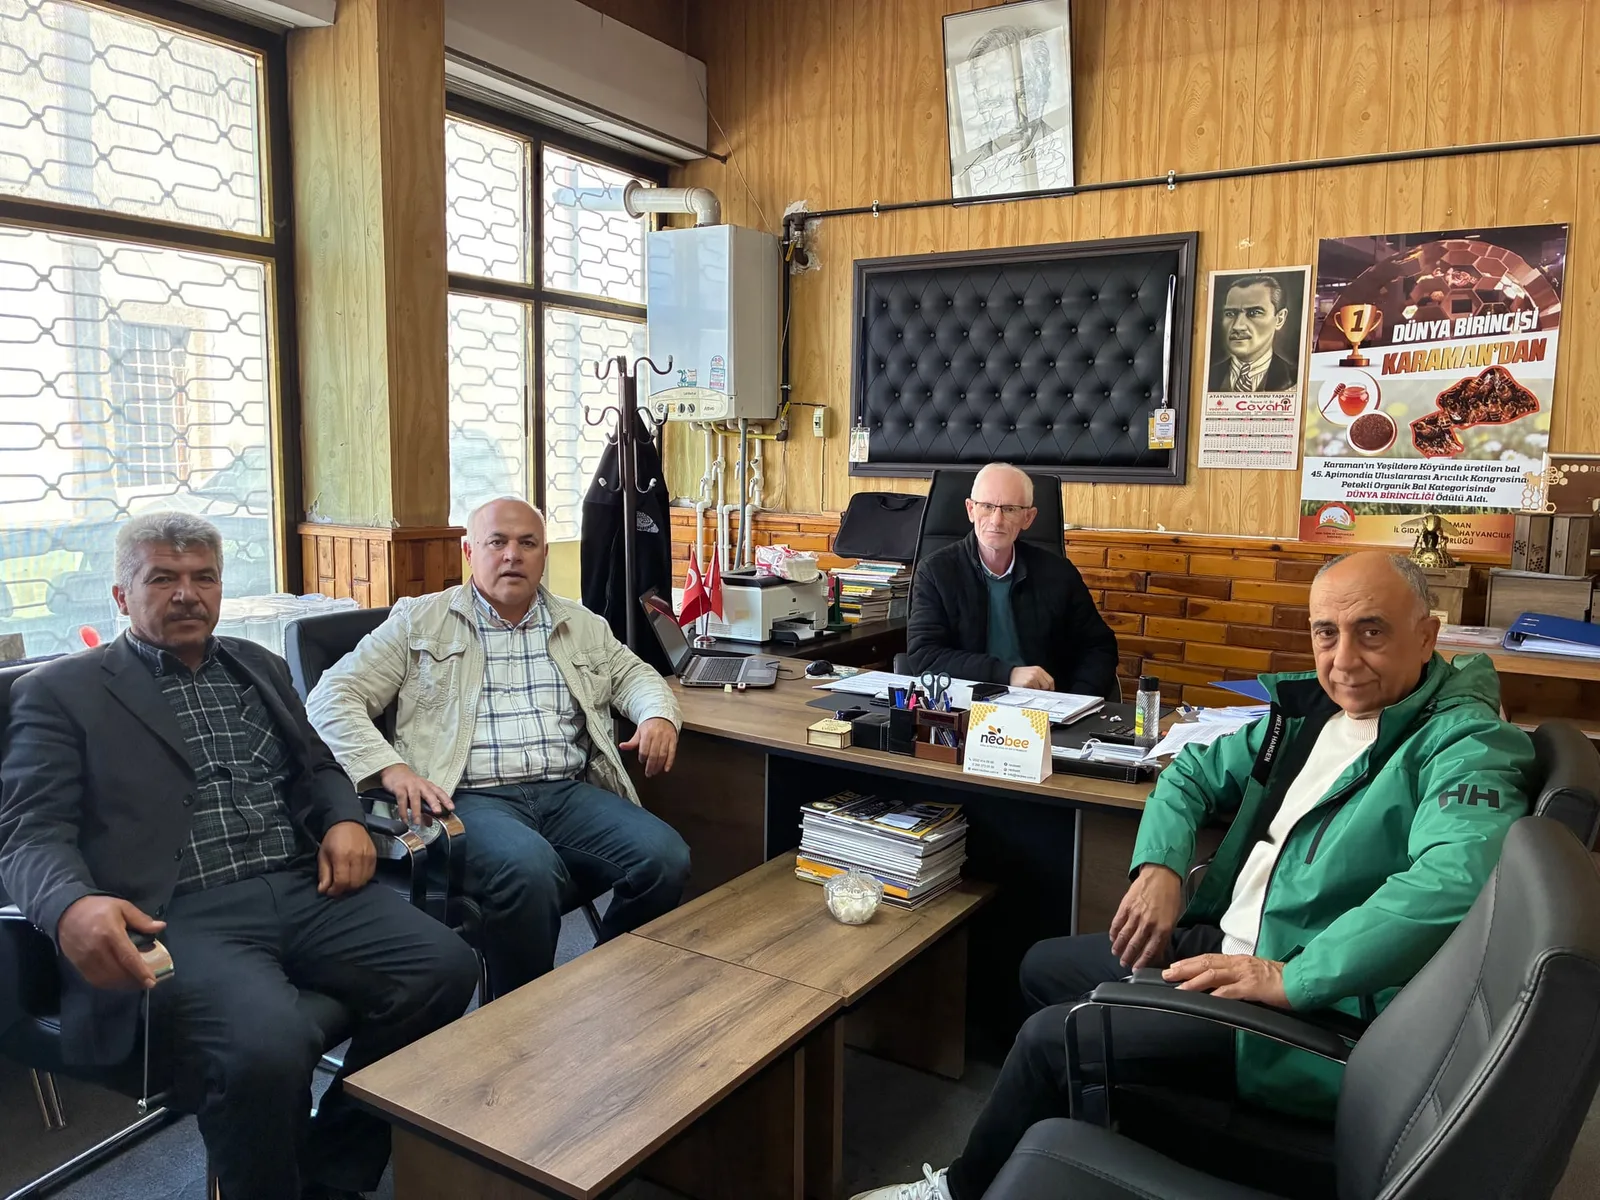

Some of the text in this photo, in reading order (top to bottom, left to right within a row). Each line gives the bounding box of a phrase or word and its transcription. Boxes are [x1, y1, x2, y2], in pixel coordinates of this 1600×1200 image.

[1350, 309, 1365, 332] 1
[1392, 308, 1539, 344] DÜNYA BİRİNCİSİ
[1382, 338, 1547, 376] KARAMAN'DAN
[1235, 401, 1292, 411] Cevahir
[1323, 461, 1520, 473] Karaman'ın Yeşildere Köyünde üretilen bal
[1311, 470, 1323, 478] 45.
[1324, 471, 1373, 479] Apimondia
[1374, 472, 1431, 481] Uluslararası
[1432, 473, 1469, 482] Arıcılık
[1341, 481, 1496, 493] Petekli Organik Bal Kategorisinde
[1346, 490, 1488, 503] DÜNYA BİRİNCİLİĞİ Ödülü Aldı.
[1393, 525, 1399, 533] İL
[980, 733, 1030, 749] neobee
[1264, 714, 1282, 763] HELLY HANSEN
